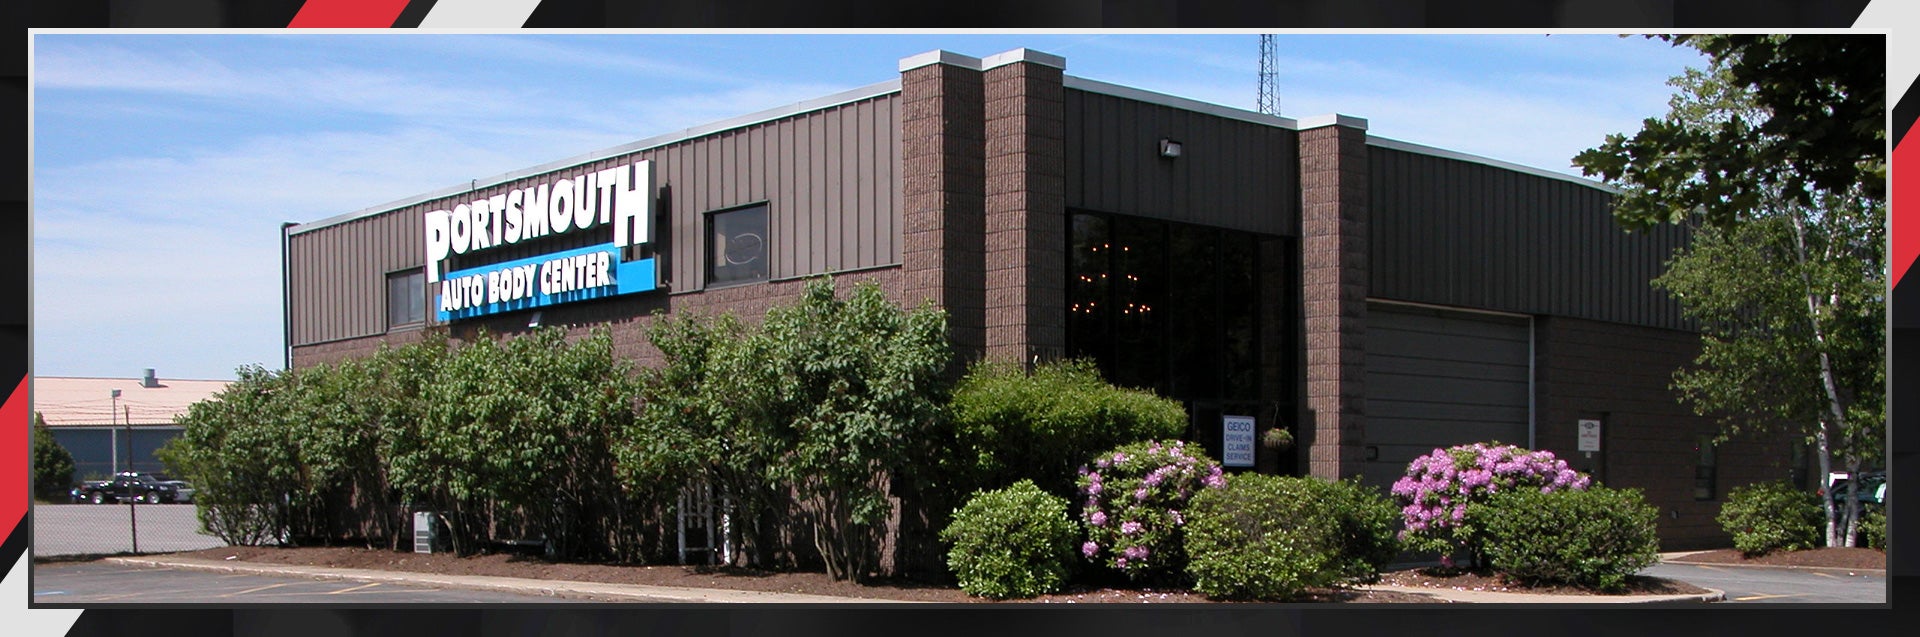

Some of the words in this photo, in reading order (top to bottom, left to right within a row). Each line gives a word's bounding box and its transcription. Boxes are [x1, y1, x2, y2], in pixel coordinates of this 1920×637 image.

[425, 159, 649, 283] PORTSMOUTH
[440, 274, 484, 311] AUTO
[488, 264, 537, 304] BODY
[540, 251, 610, 295] CENTER
[1227, 422, 1251, 432] GEICO
